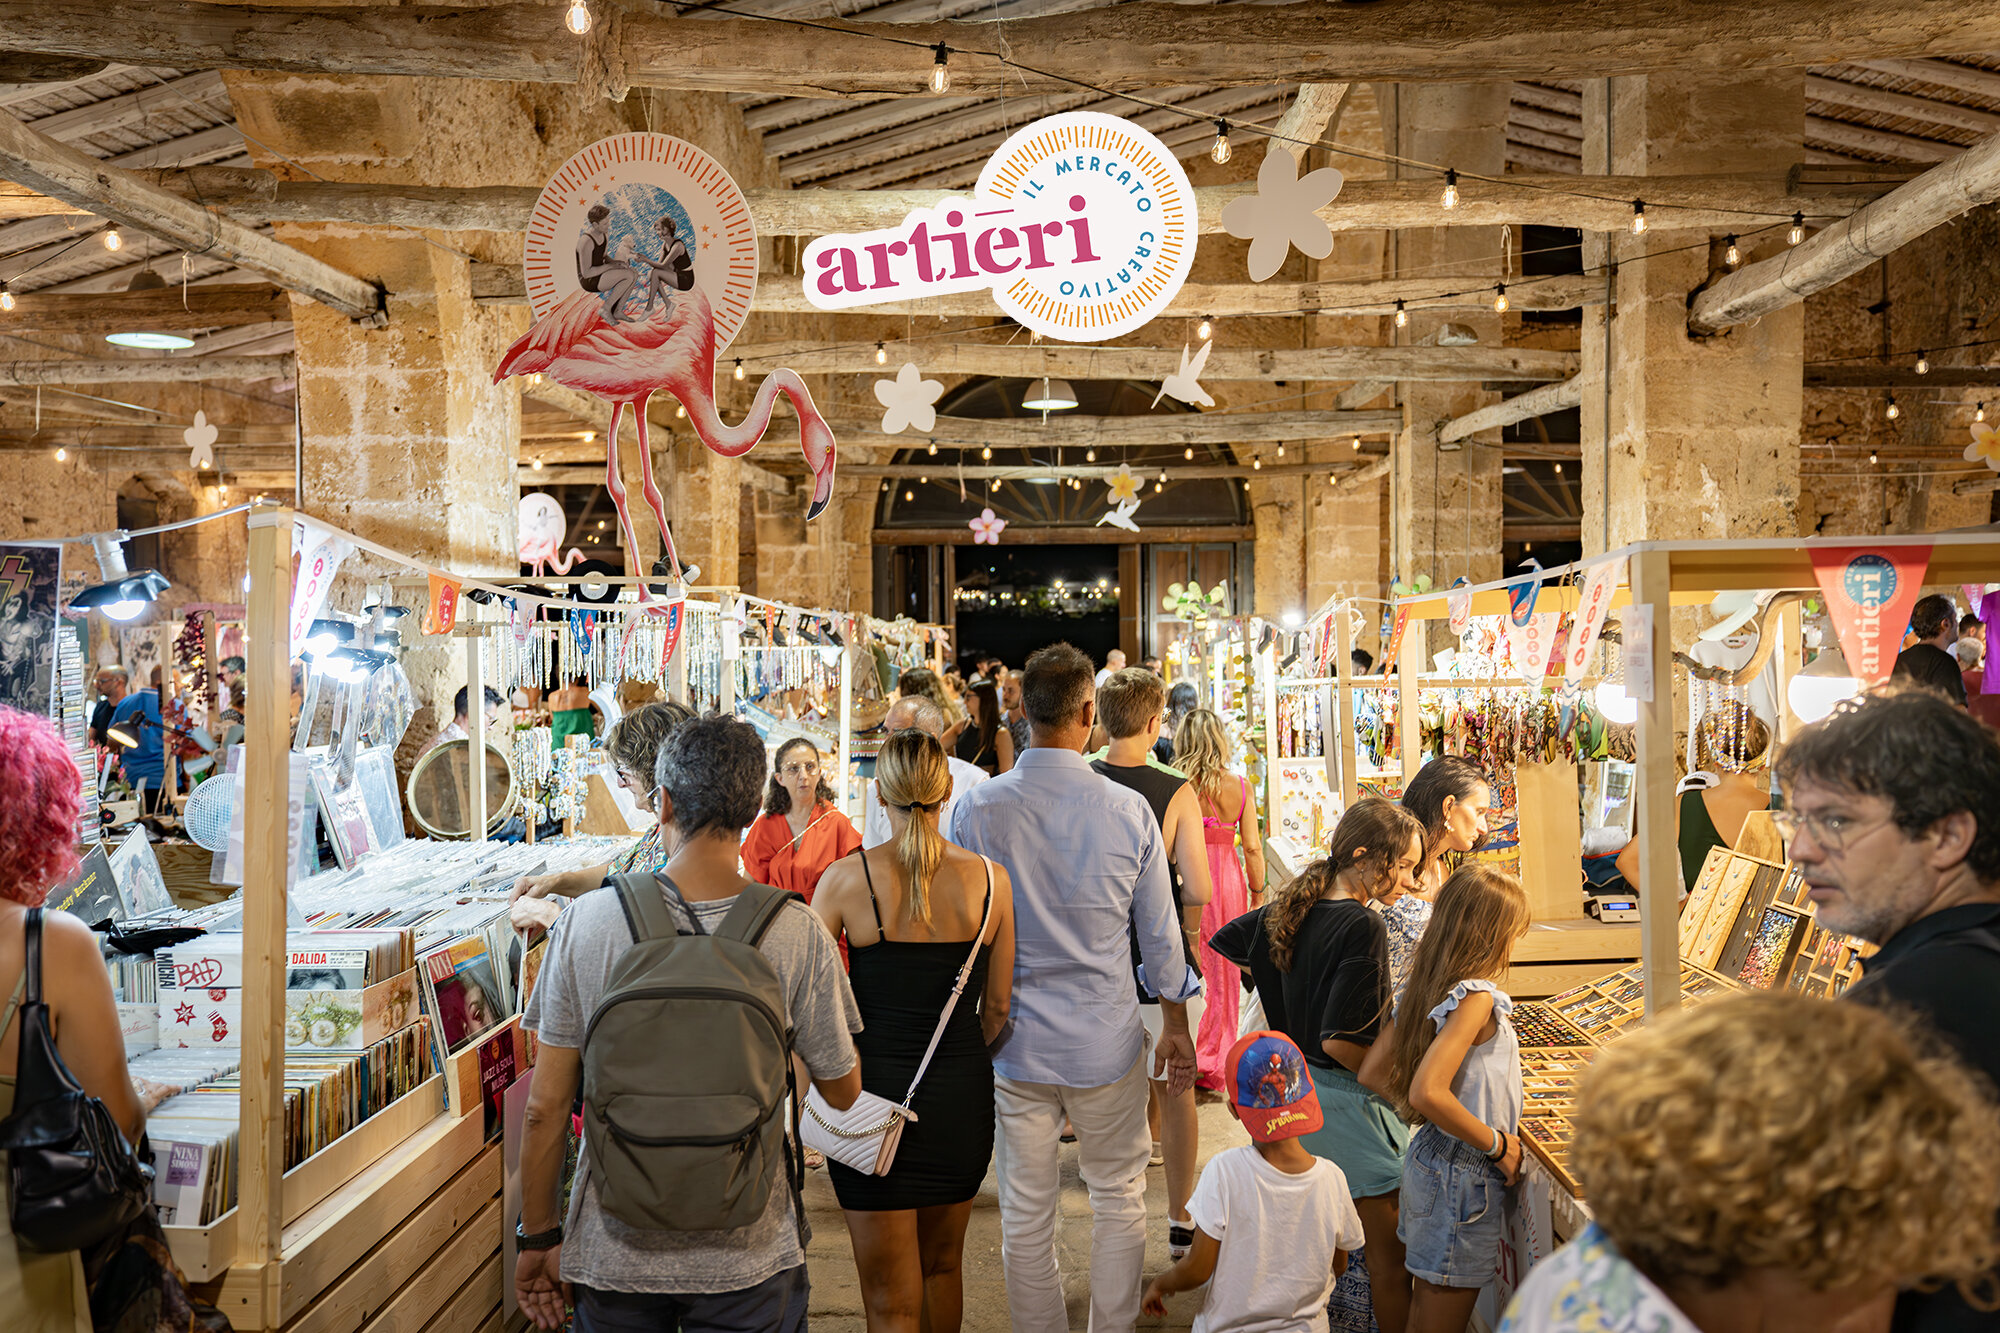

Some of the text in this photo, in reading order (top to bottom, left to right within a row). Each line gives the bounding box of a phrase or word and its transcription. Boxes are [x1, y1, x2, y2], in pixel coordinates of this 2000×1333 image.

[1023, 156, 1154, 298] IL MERCATO CREATIVO
[156, 953, 176, 989] MICHA
[292, 953, 327, 965] DALIDA
[170, 957, 223, 989] BAD
[483, 1065, 496, 1083] JAZZ
[500, 1054, 514, 1071] SOUL
[491, 1072, 508, 1093] MUSIC
[170, 1160, 198, 1169] SIMONE
[173, 1146, 200, 1161] NINA
